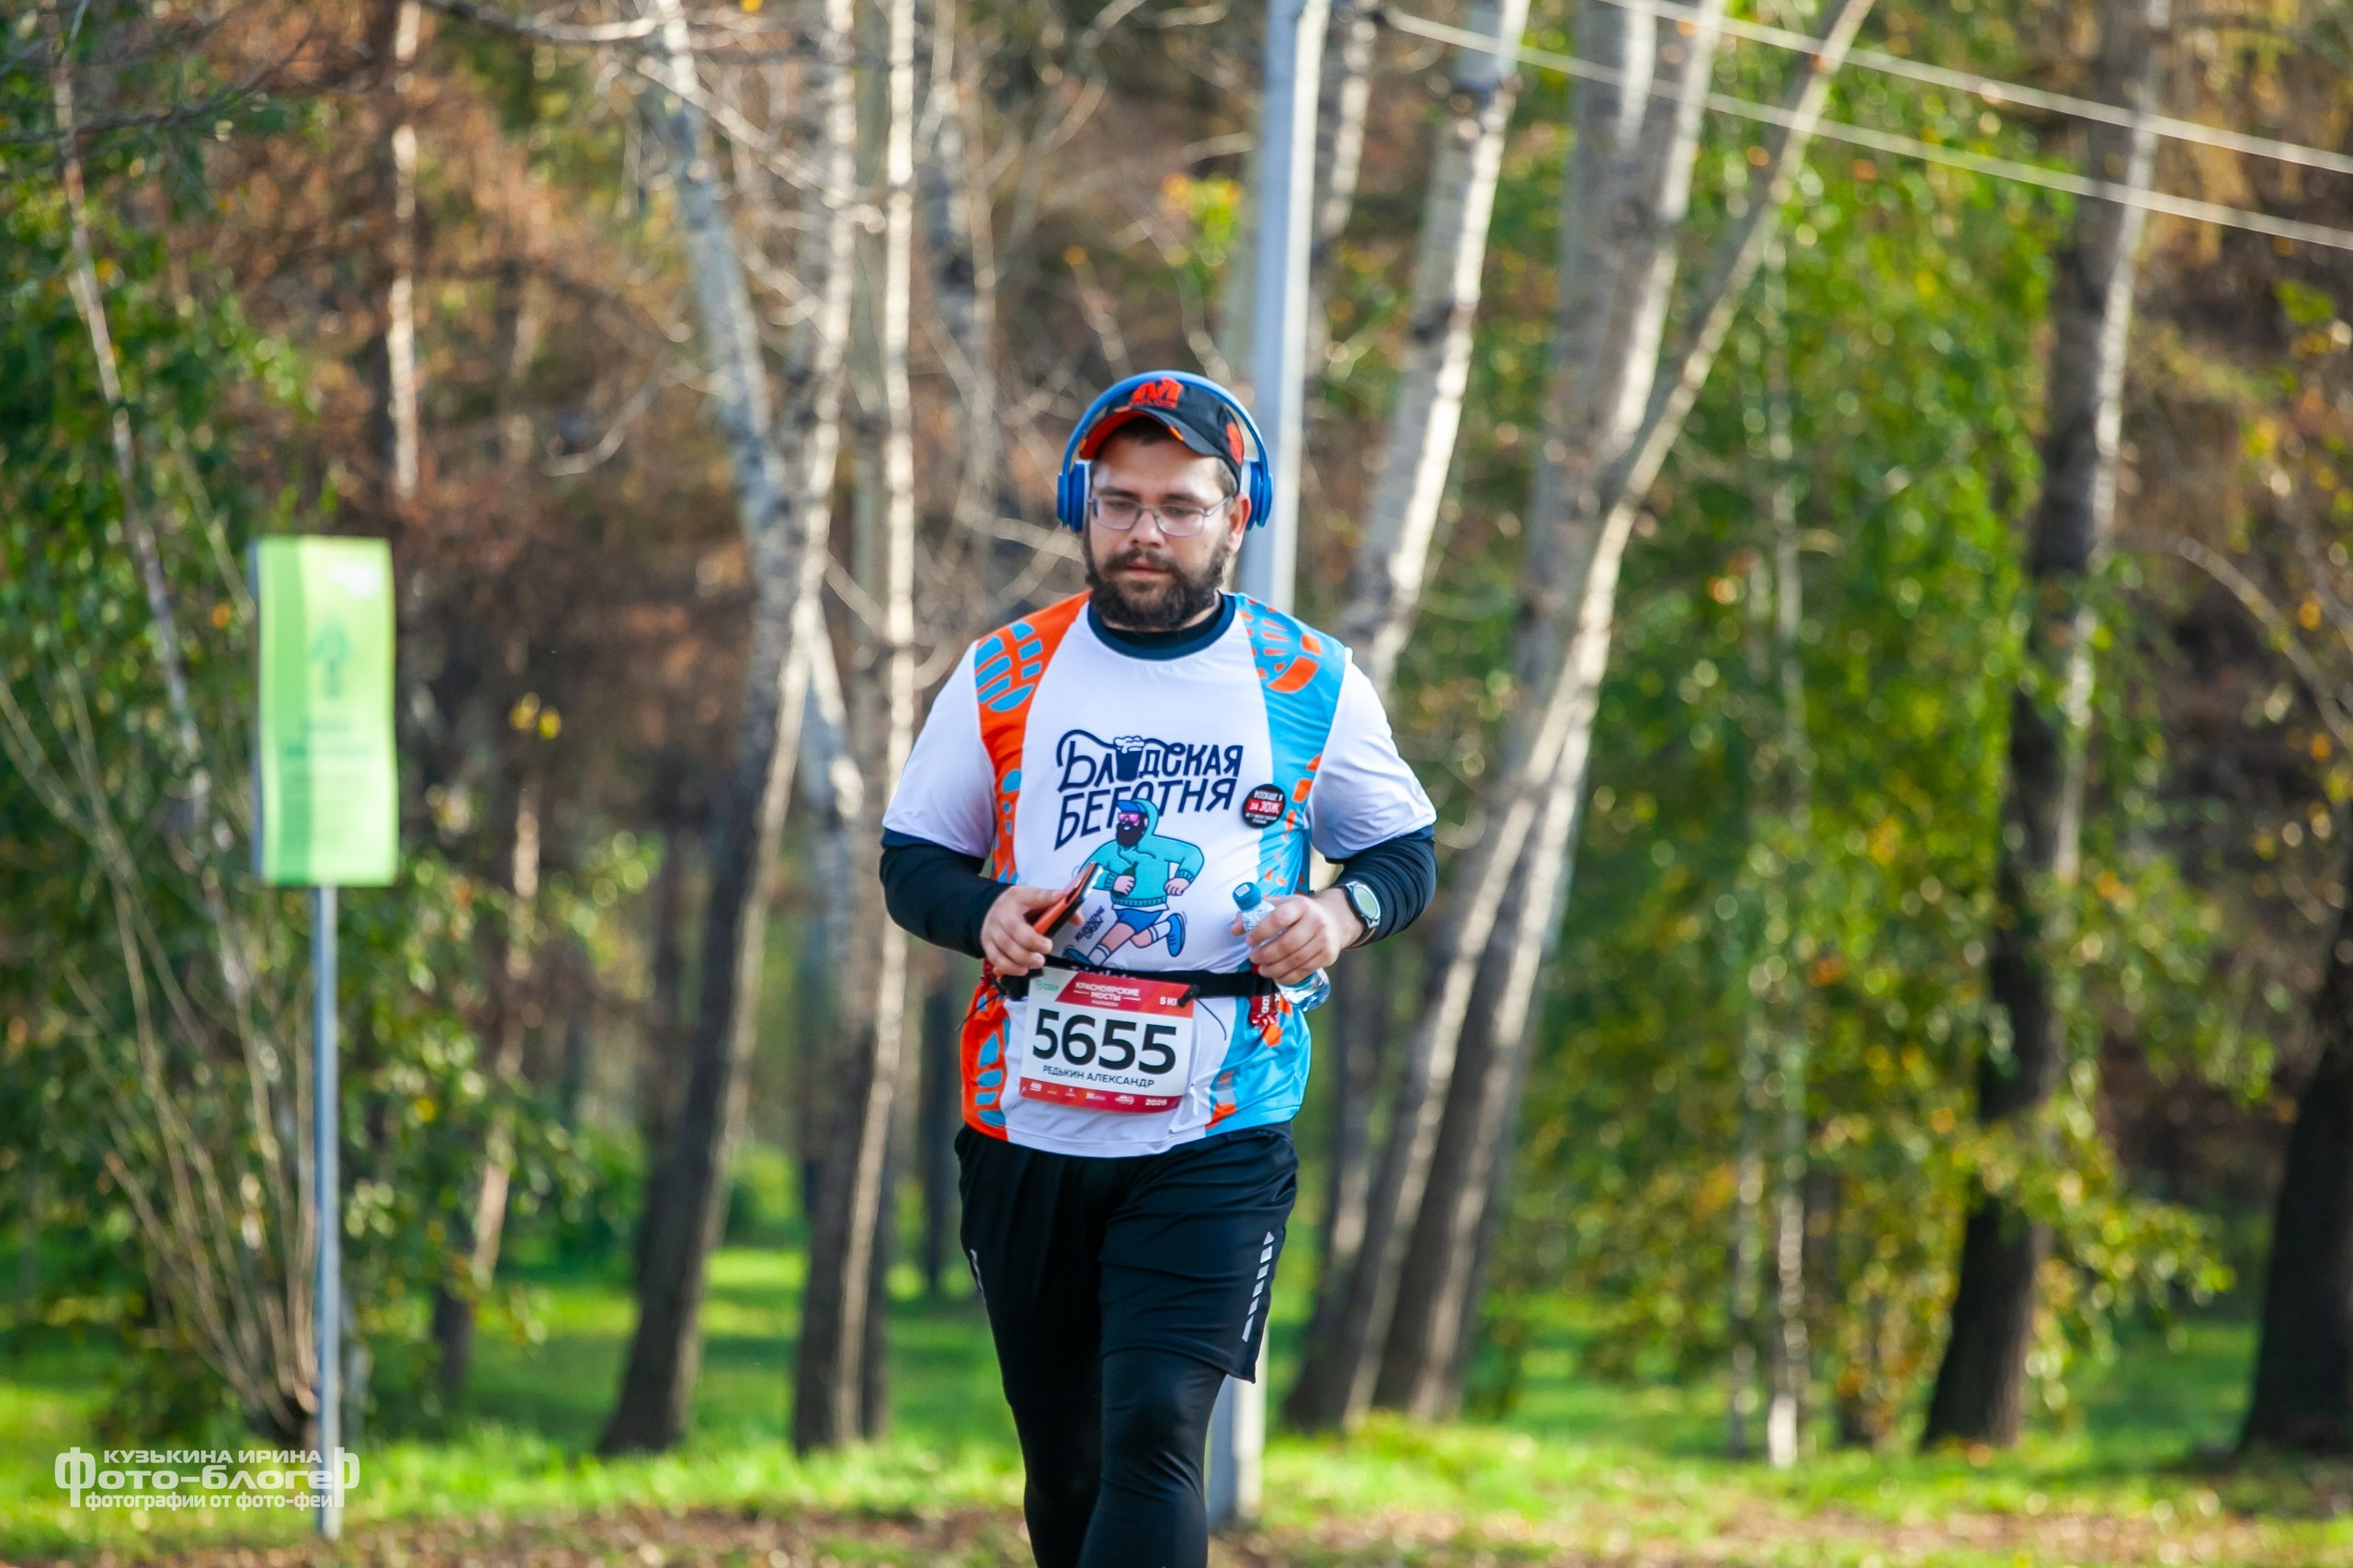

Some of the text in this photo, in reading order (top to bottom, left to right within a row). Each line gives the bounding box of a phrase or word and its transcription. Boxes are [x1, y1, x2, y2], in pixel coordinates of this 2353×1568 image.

[1259, 800, 1280, 814] ЗОЖ
[1075, 982, 1140, 996] КРАСНОЯРСКИЕ
[1090, 992, 1121, 1002] МОСТЫ
[1159, 996, 1166, 1006] 5
[1033, 1008, 1177, 1074] 5655
[1043, 1065, 1154, 1088] РЕДЬКИН АЛЕКСАНДР
